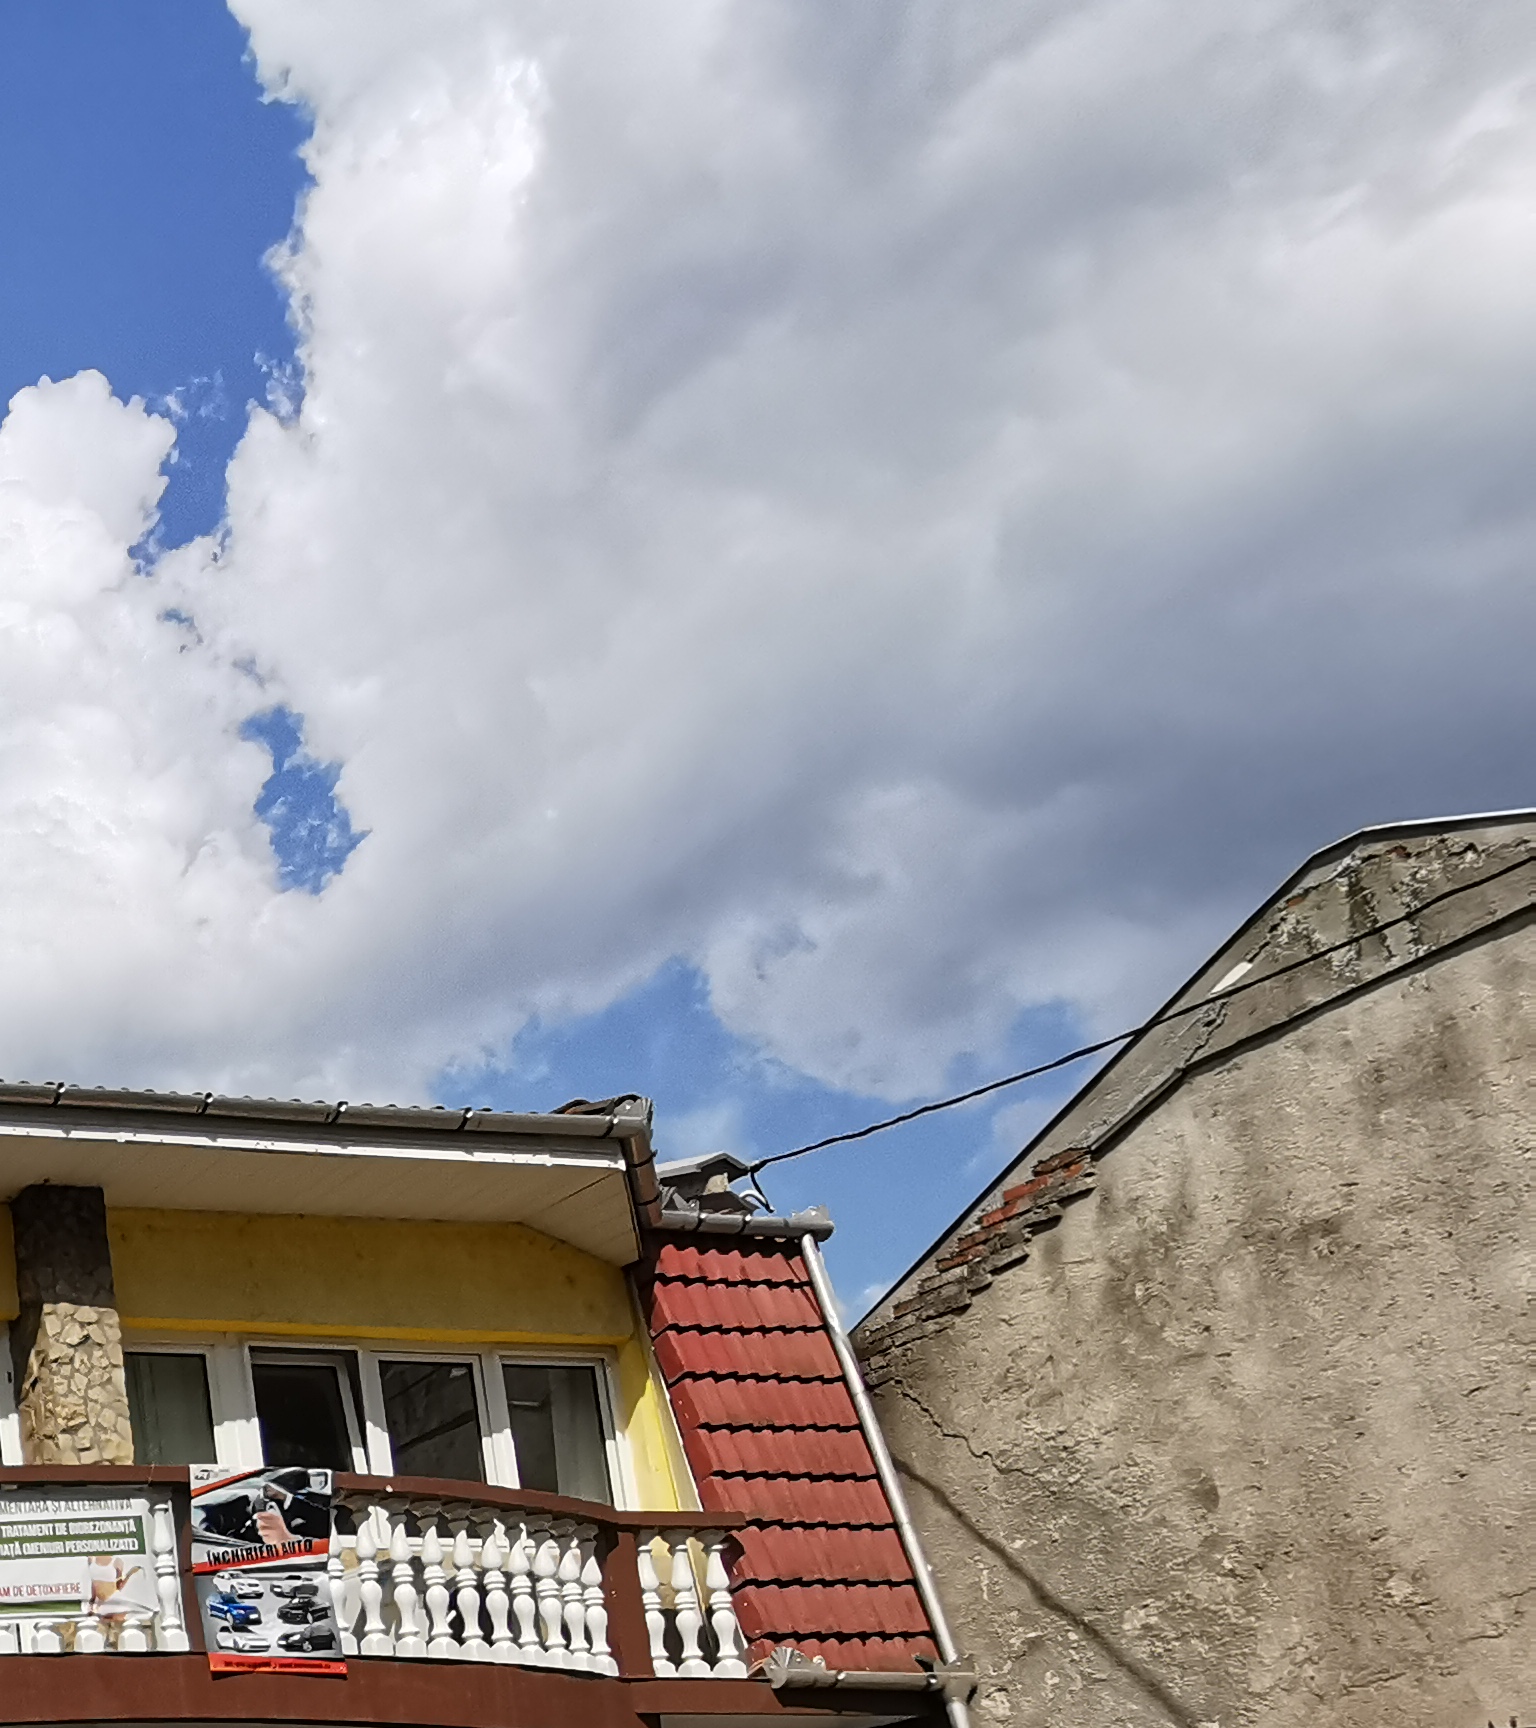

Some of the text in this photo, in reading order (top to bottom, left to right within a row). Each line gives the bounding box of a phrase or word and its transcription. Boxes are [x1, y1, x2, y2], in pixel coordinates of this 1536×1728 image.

[1, 1523, 53, 1538] TRATAMENT
[55, 1522, 68, 1535] DE
[281, 1538, 313, 1556] AUTO
[12, 1585, 25, 1597] DE
